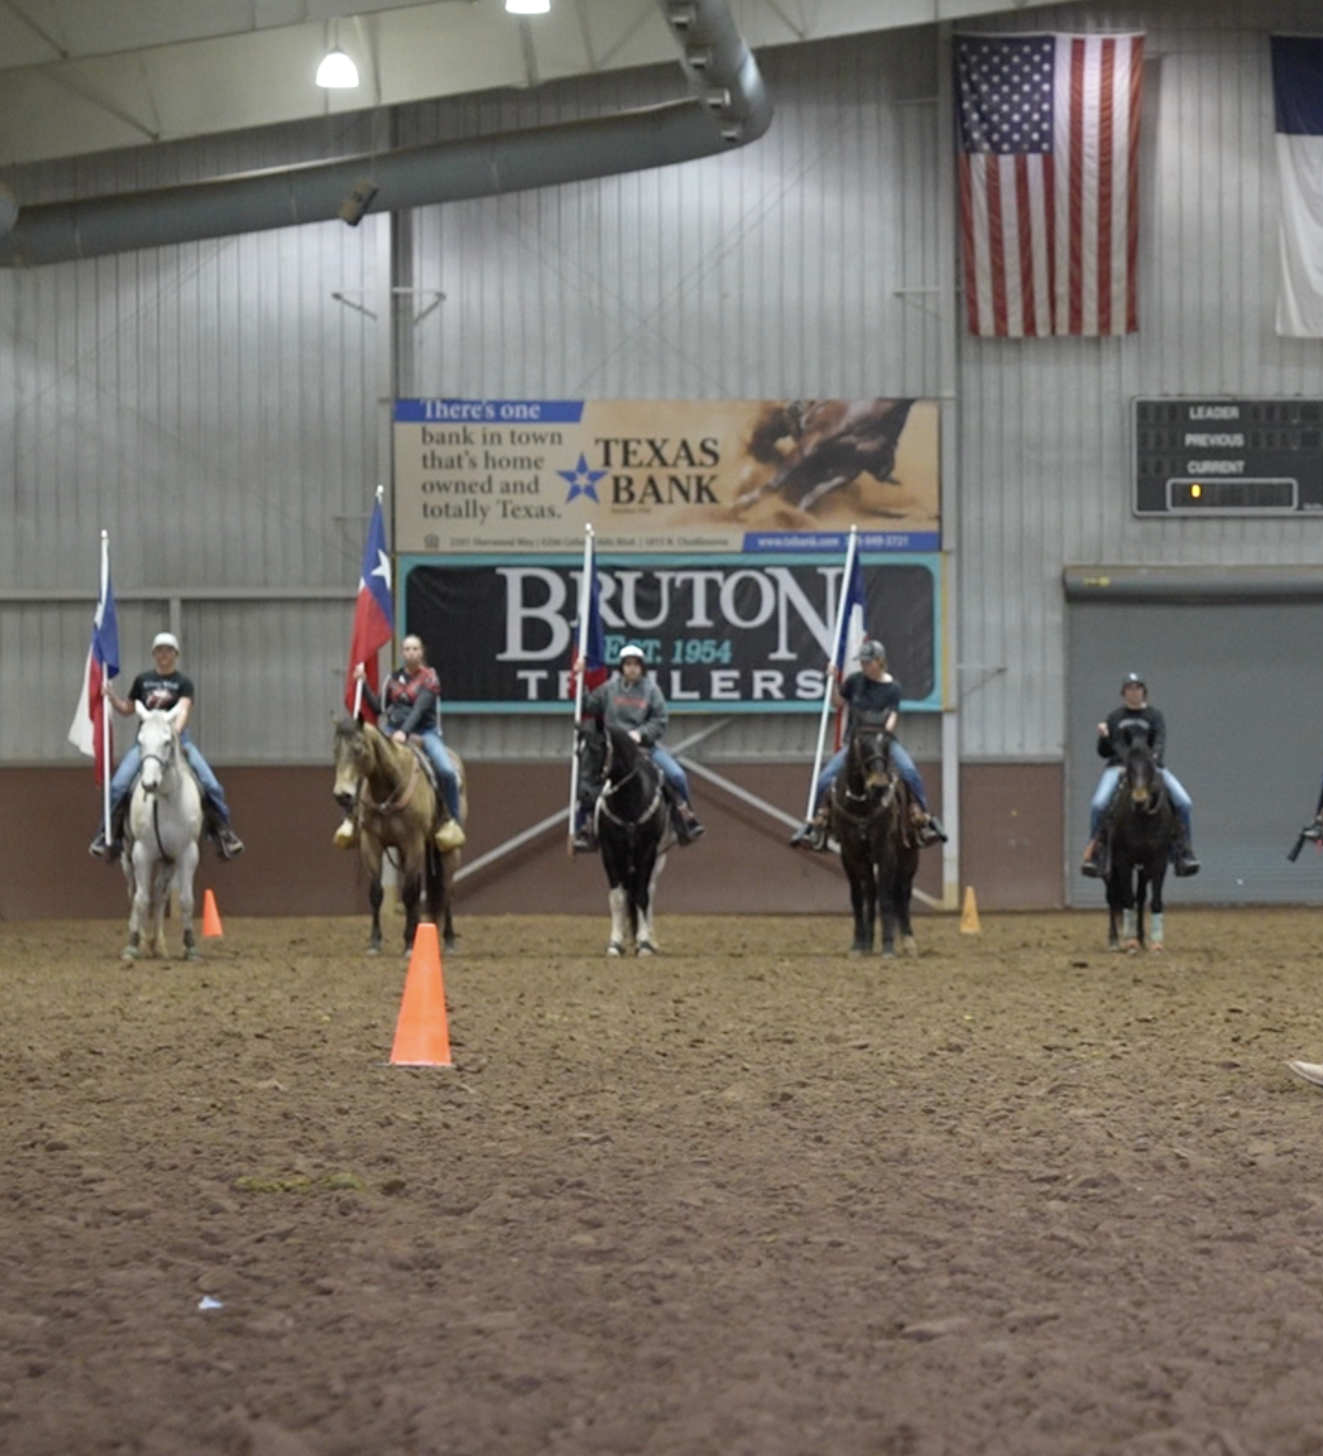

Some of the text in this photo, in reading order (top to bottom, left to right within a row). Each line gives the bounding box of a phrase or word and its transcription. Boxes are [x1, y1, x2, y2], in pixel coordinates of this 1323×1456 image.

[420, 400, 541, 420] There's one
[1188, 406, 1239, 420] LEADER
[421, 426, 563, 445] bank in town
[1184, 433, 1245, 447] PREVIOUS
[421, 450, 545, 470] that's home
[594, 437, 720, 468] TEXAS
[1187, 460, 1245, 474] CURRENT
[421, 474, 539, 494] owned and
[611, 474, 719, 504] BANK
[422, 499, 563, 525] totally Texas.
[495, 567, 847, 661] BRUTON
[669, 638, 733, 665] 1954
[517, 669, 826, 700] TILERS
